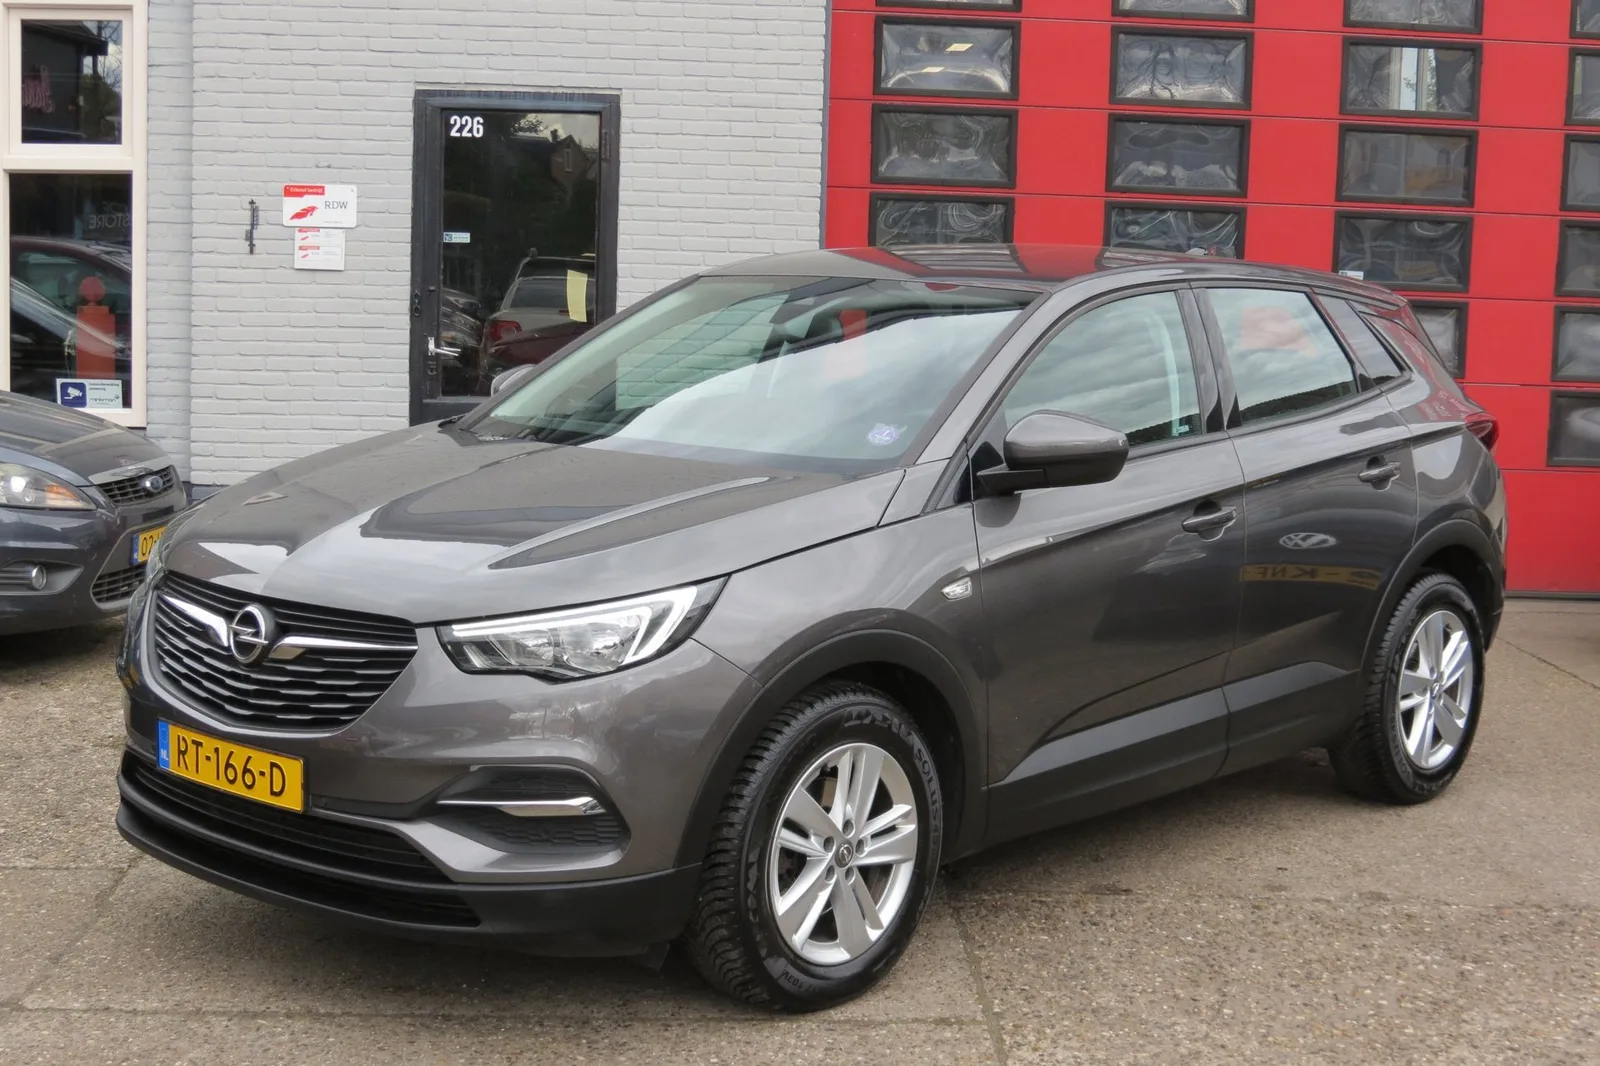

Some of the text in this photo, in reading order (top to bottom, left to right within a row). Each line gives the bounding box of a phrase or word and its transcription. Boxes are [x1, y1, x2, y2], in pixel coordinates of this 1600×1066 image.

[450, 115, 484, 138] 226
[324, 200, 348, 210] RDW
[177, 734, 286, 797] RT-166-D
